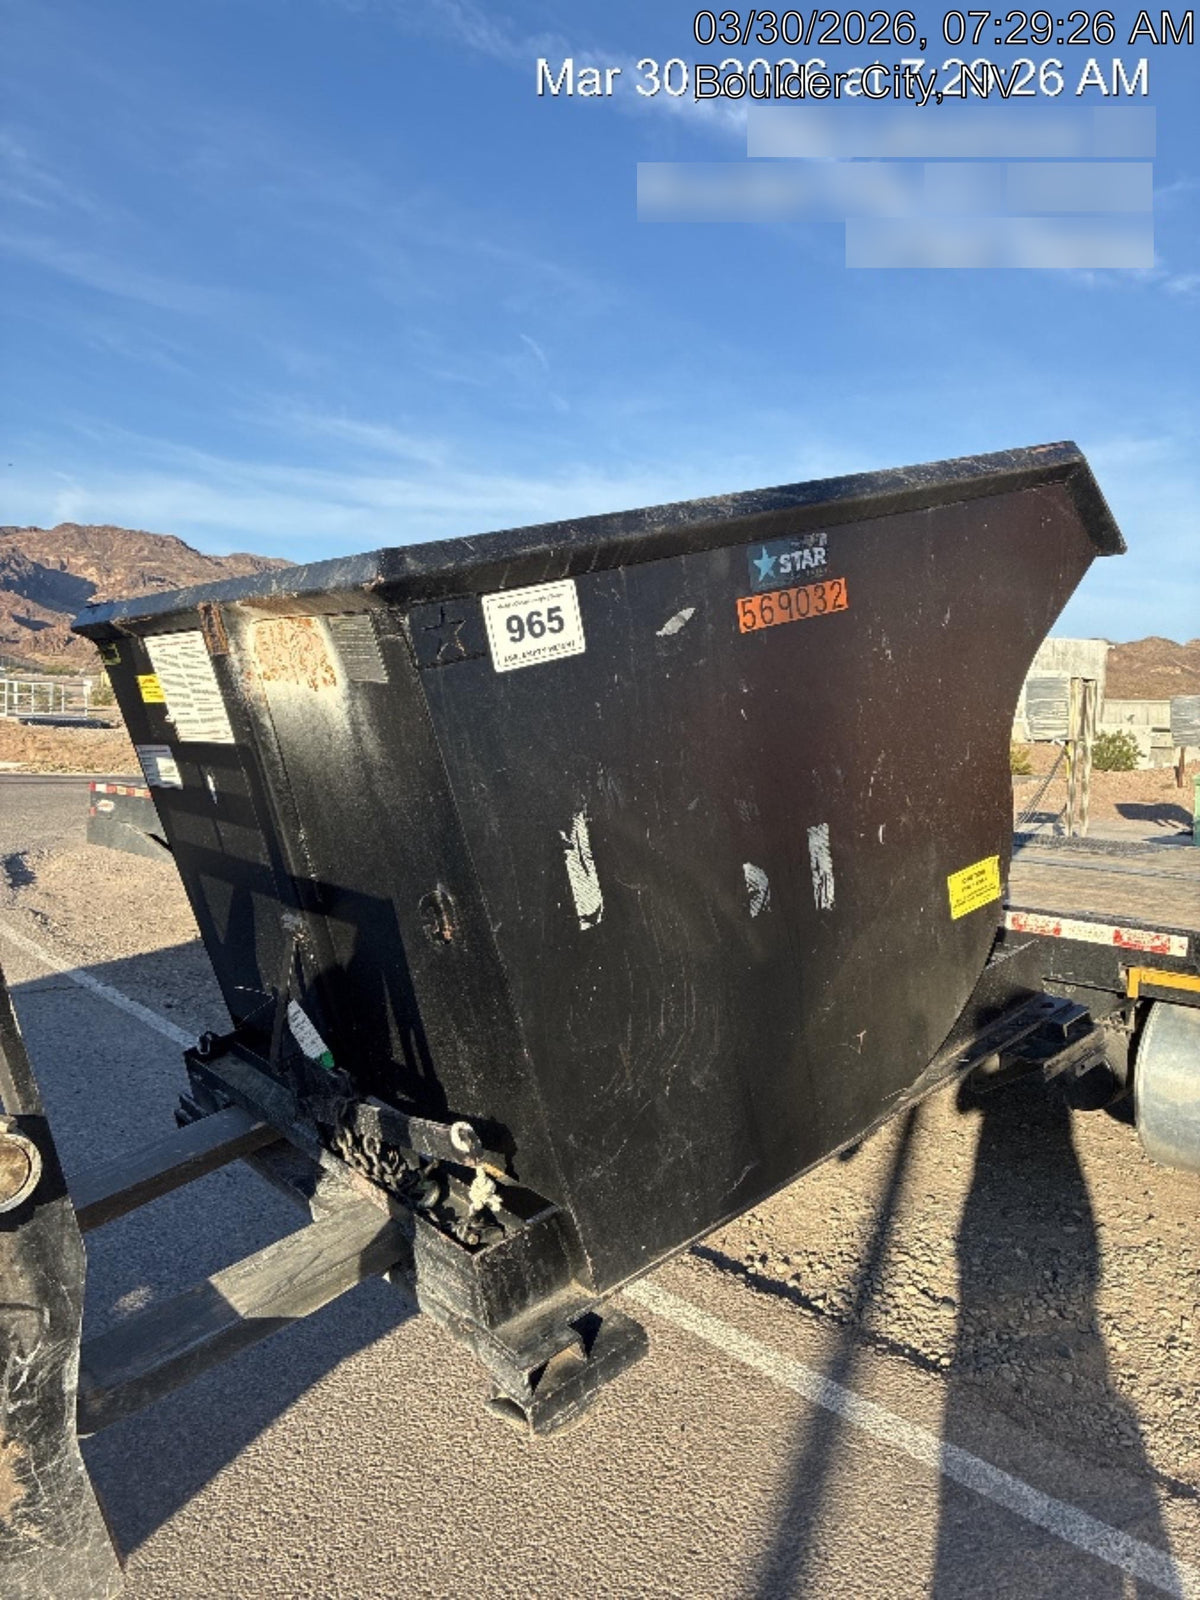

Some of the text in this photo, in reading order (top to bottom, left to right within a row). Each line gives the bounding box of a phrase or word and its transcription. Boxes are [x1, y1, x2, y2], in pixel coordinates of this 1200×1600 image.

[779, 547, 828, 574] STAR
[741, 580, 844, 629] 569032
[506, 605, 564, 643] 965
